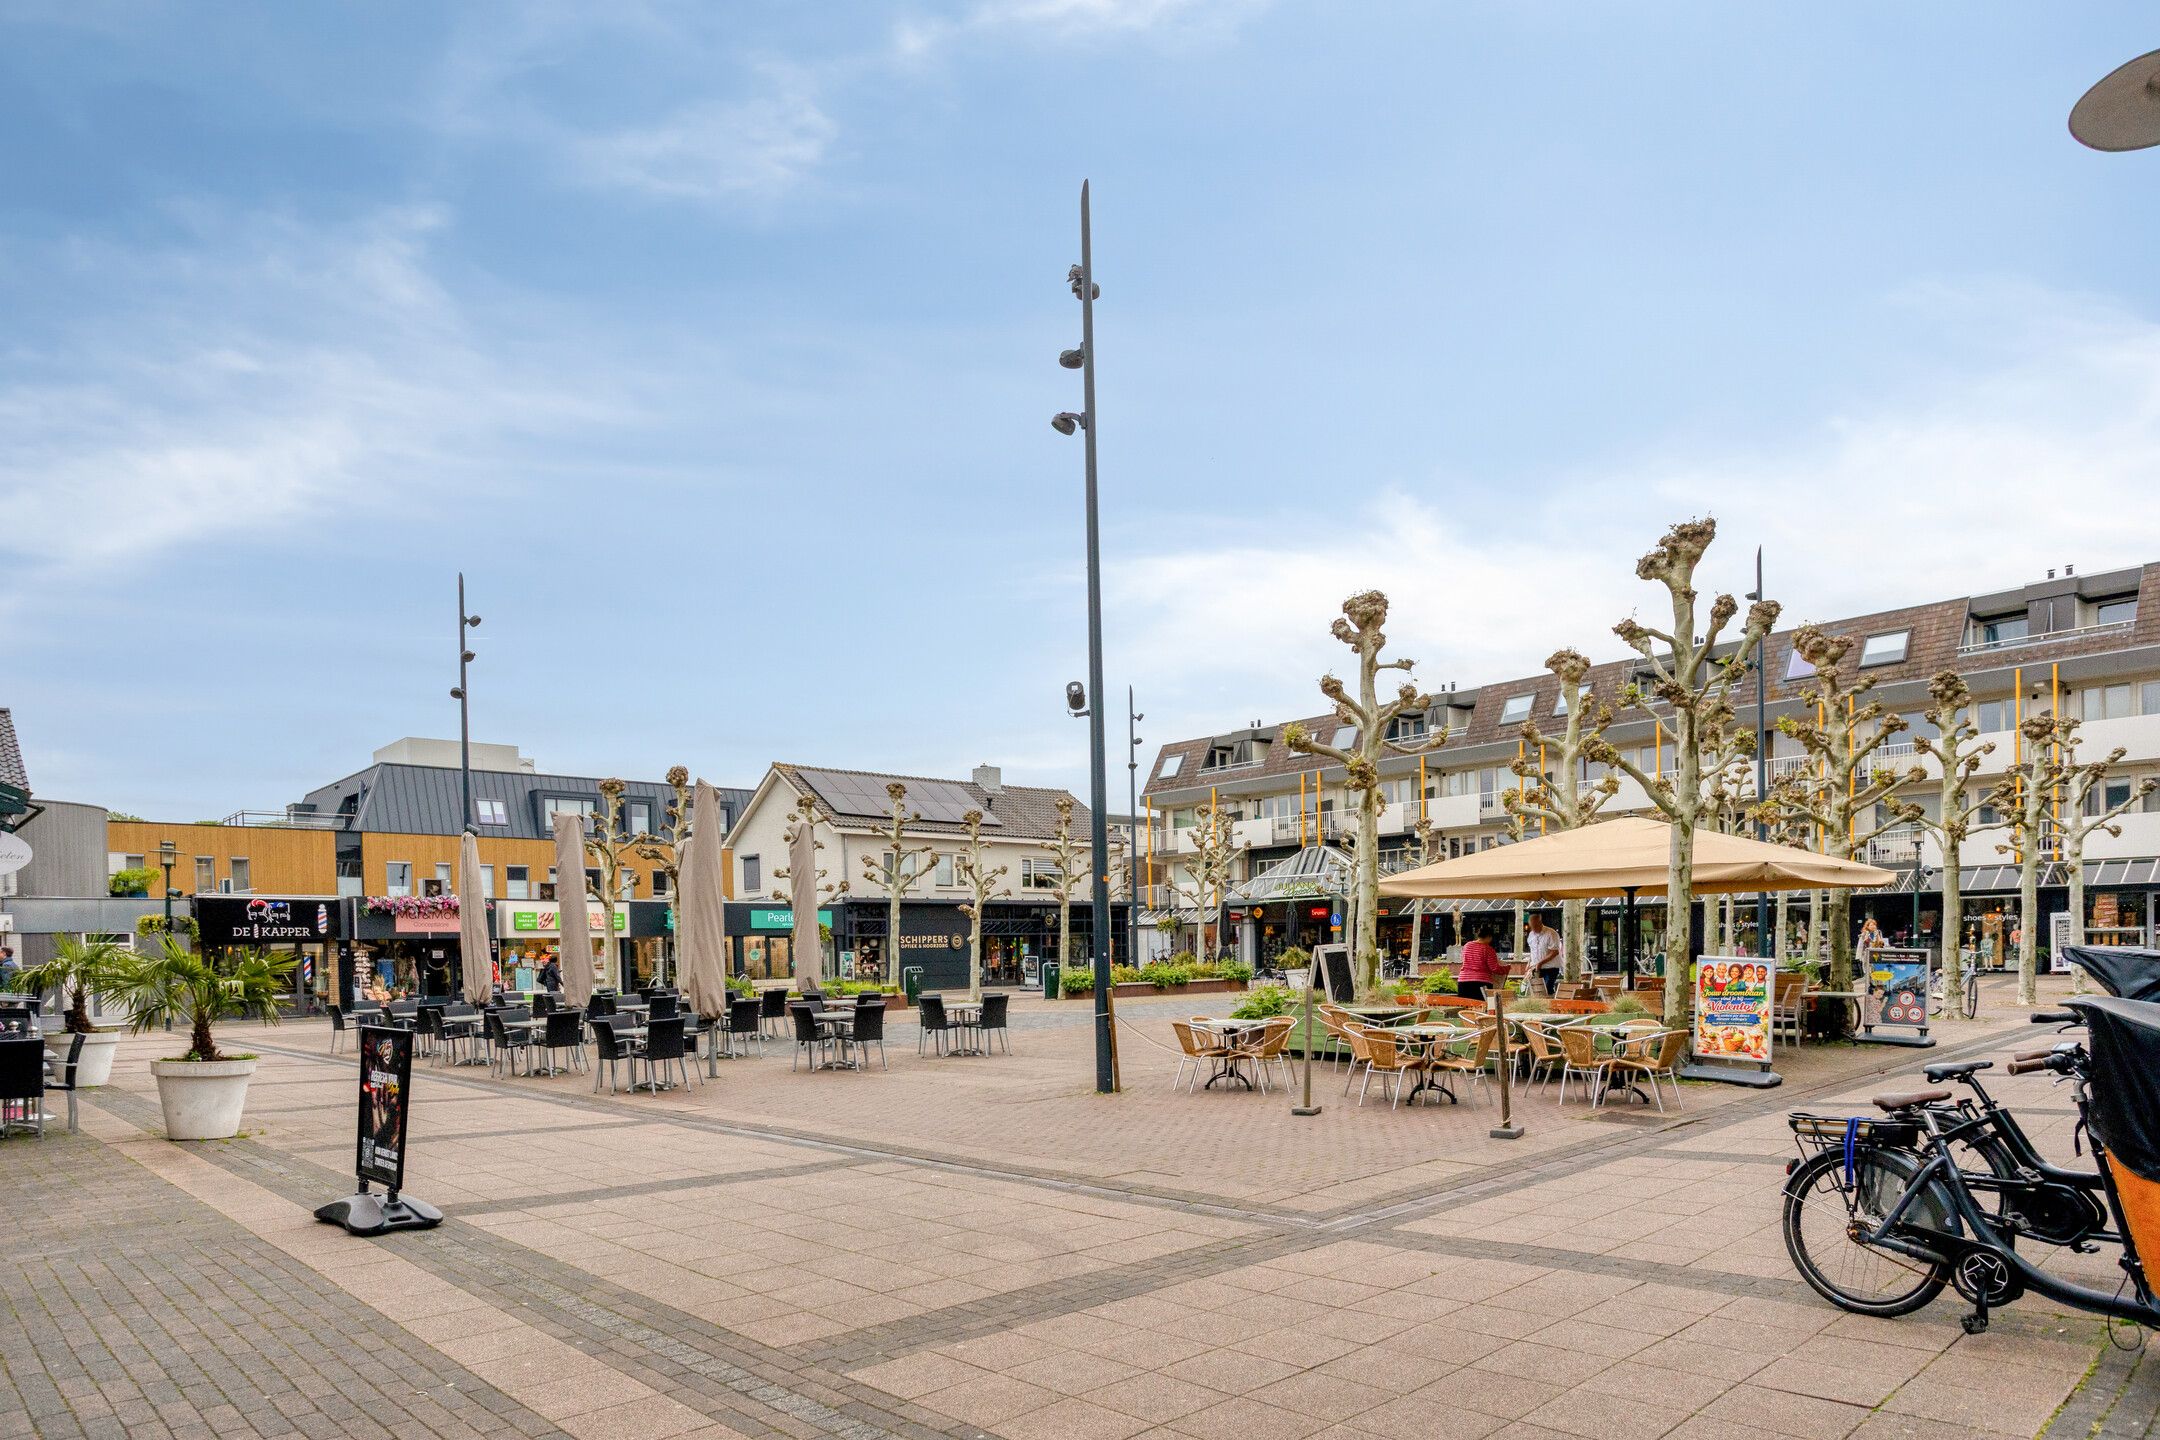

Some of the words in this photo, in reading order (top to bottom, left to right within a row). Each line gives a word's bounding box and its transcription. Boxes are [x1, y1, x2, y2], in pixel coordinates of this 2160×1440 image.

[1995, 913, 2018, 922] styles
[232, 927, 251, 937] DE
[261, 927, 311, 937] KAPPER
[900, 935, 948, 944] SCHIPPERS
[1703, 989, 1721, 998] Jouw
[1722, 989, 1764, 997] droombaan
[1708, 1001, 1757, 1012] Violento!
